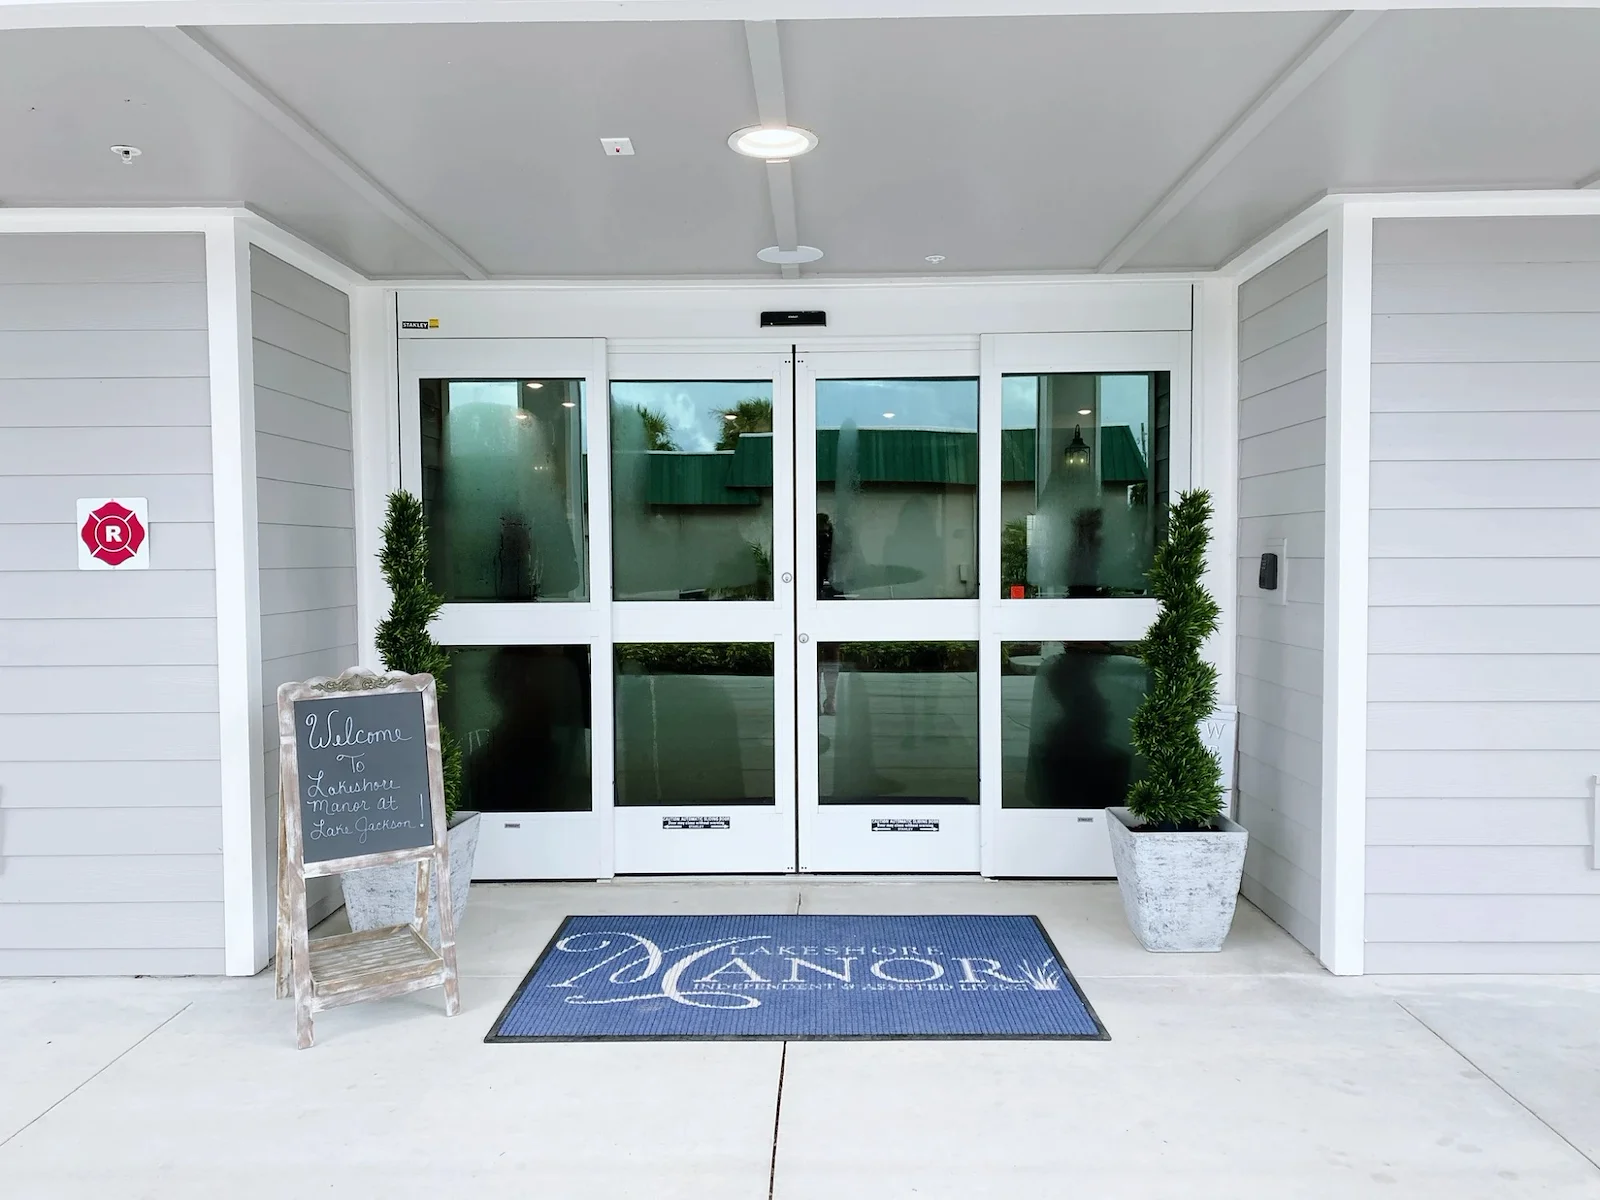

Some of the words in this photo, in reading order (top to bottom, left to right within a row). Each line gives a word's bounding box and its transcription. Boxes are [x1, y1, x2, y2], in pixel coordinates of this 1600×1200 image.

[105, 525, 122, 543] R
[306, 709, 413, 750] Welcome
[336, 752, 365, 773] To
[307, 770, 401, 798] Lakeshore
[309, 818, 354, 841] Lake
[729, 945, 944, 956] LAKESHORE
[692, 983, 836, 991] INDEPENDENT
[861, 983, 954, 991] ASSISTED
